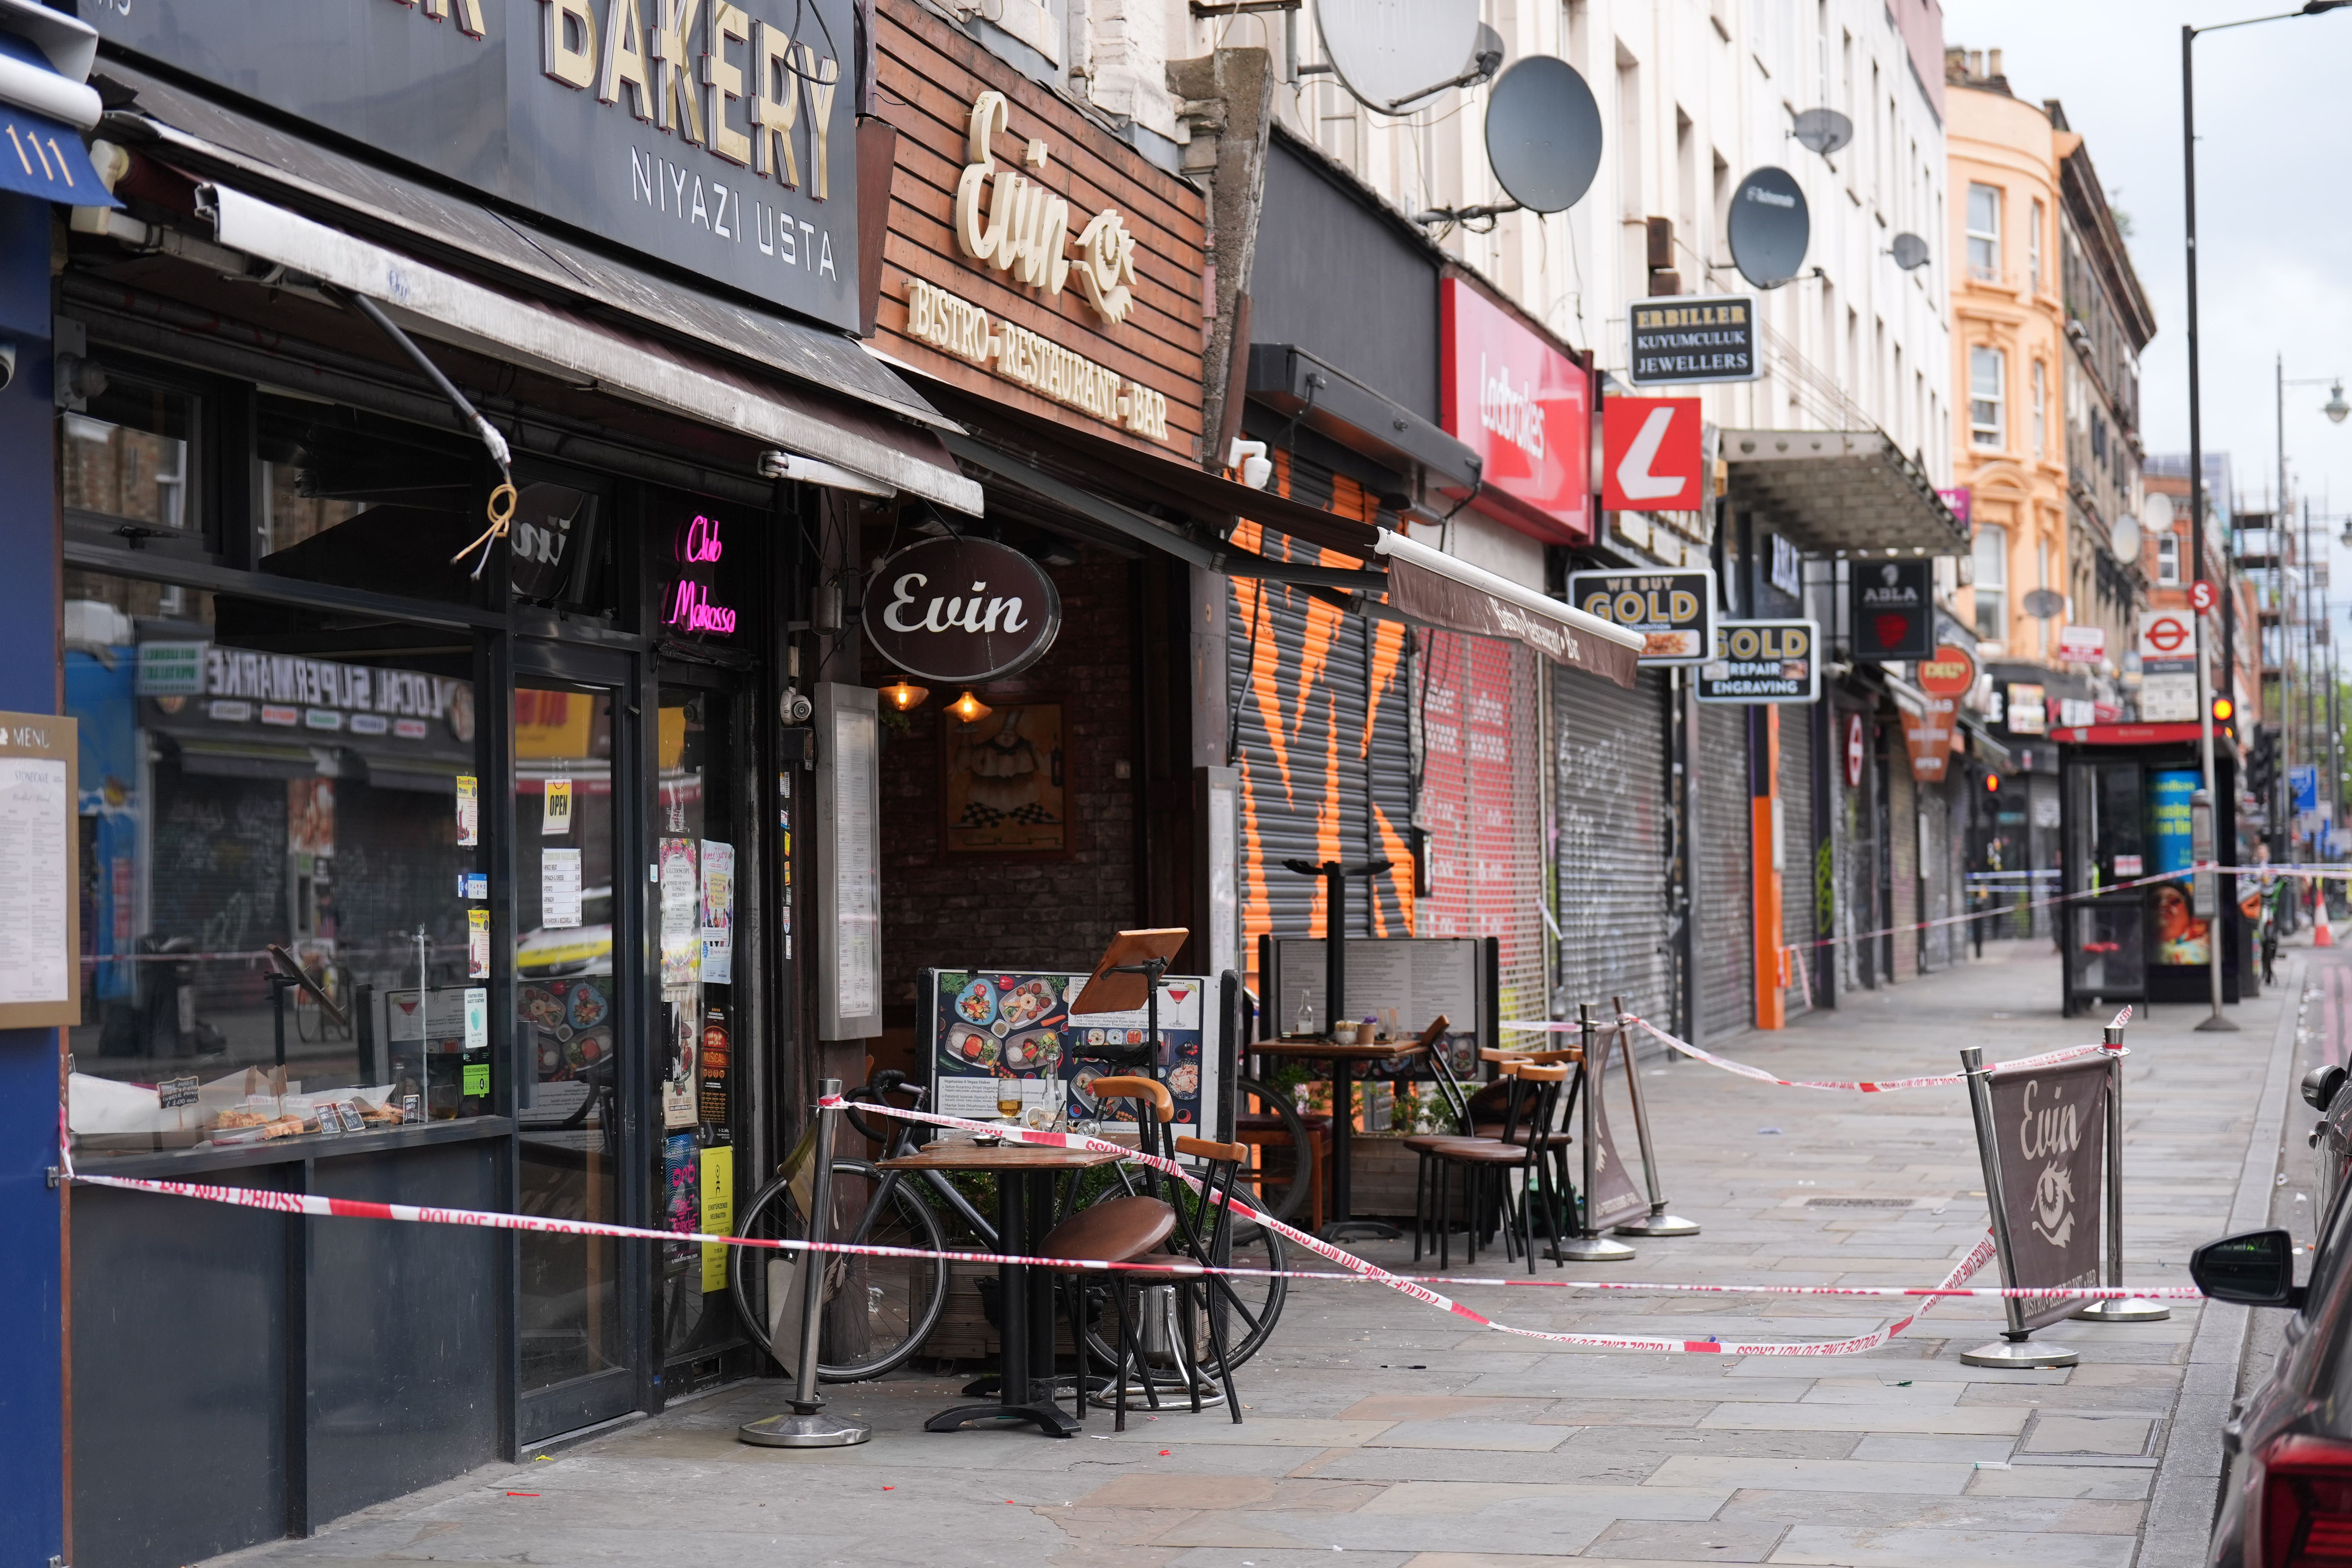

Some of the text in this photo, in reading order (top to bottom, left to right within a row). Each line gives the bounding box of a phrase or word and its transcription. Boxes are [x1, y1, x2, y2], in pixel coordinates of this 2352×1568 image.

[544, 0, 837, 201] BAKERY
[6, 124, 74, 187] 111
[956, 91, 1069, 295] Evin
[632, 145, 838, 282] NIYAZI USTA
[1636, 306, 1746, 328] ERBILLER
[1637, 330, 1746, 350] KUYUMCULUK
[907, 277, 1169, 441] BISTRO RESTAURANT BAR
[1638, 352, 1748, 373] JEWELLERS
[1480, 351, 1546, 461] Ladbrokes
[687, 515, 722, 562] Club
[1606, 577, 1674, 591] WE BUY
[2194, 583, 2210, 607] S
[883, 573, 1028, 633] Evin
[1583, 590, 1699, 624] GOLD
[1563, 625, 1581, 661] Bar
[1729, 661, 1781, 676] REPAIR
[1711, 680, 1798, 695] ENGRAVING
[13, 727, 51, 748] MENU
[550, 795, 568, 816] OPEN
[704, 847, 728, 870] Queer Diary
[704, 1052, 725, 1064] MUSICAL
[162, 1093, 182, 1102] CHEESE
[2020, 1080, 2082, 1161] Evin
[192, 1184, 231, 1202] NOT
[238, 1188, 305, 1214] CROSS
[708, 1202, 728, 1211] EINSTÜRZENDE
[418, 1207, 486, 1227] POLICE
[494, 1215, 537, 1231] LINE
[710, 1212, 726, 1220] NEUBAUTEN
[1270, 1219, 1312, 1245] CROSS
[1312, 1240, 1341, 1260] NOT
[1341, 1254, 1362, 1270] DO
[1394, 1279, 1440, 1305] POLICE
[1971, 1238, 1996, 1269] POLICE
[1953, 1270, 1963, 1289] DO
[1960, 1256, 1976, 1282] LINE
[2086, 1269, 2097, 1288] BAR
[1736, 1332, 1882, 1356] POLICE LINE DO NOT CROSS
